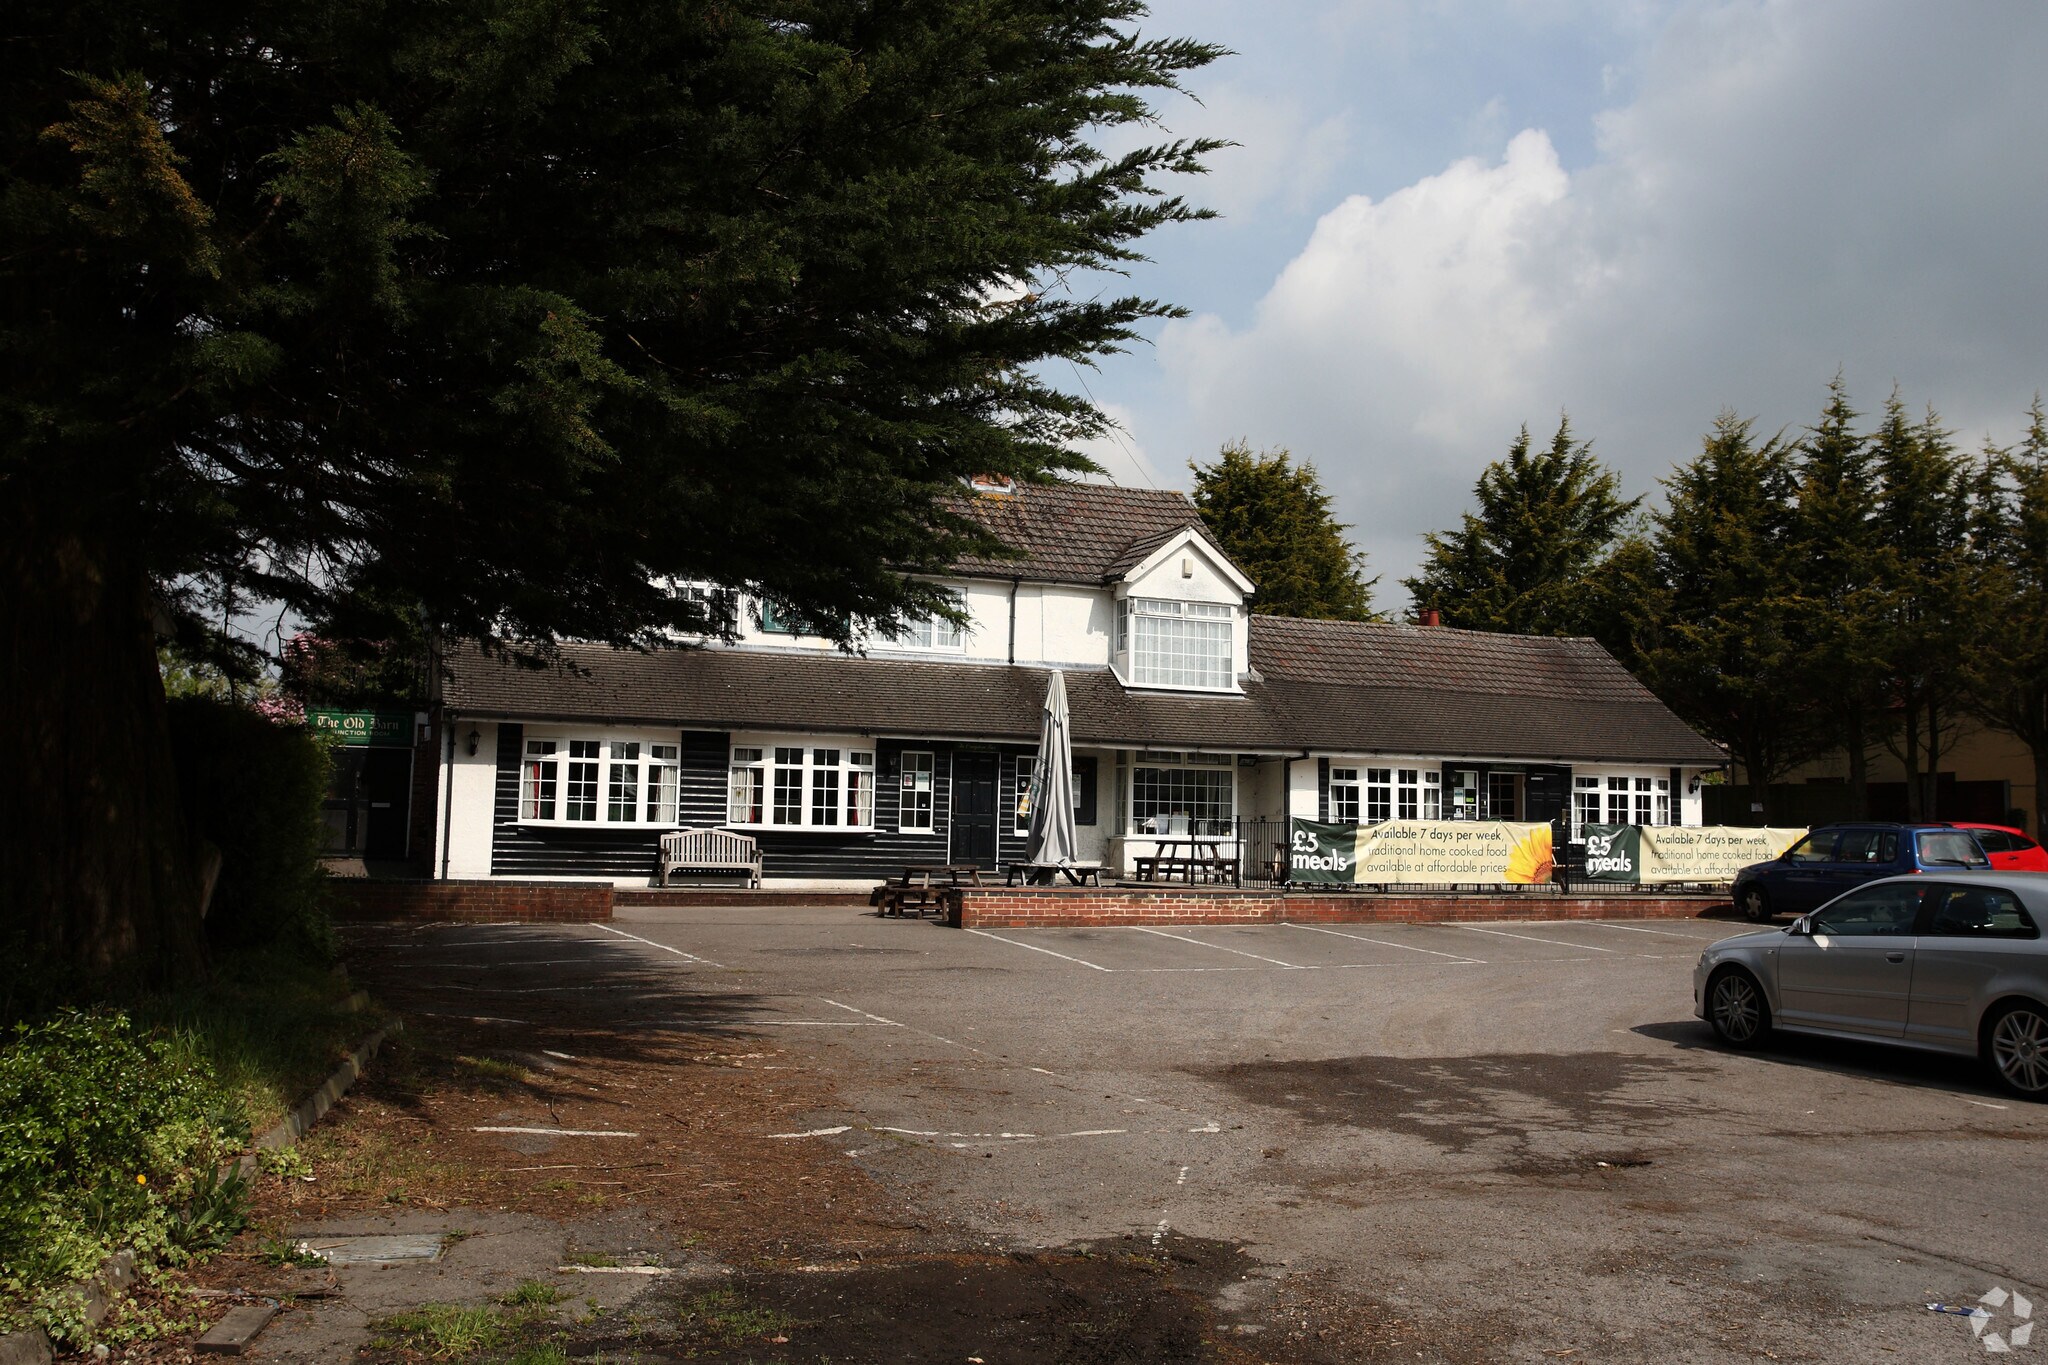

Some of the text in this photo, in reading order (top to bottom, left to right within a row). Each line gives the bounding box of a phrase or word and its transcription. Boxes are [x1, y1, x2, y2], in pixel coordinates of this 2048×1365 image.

[317, 716, 340, 728] The
[343, 717, 365, 729] Old
[1292, 830, 1319, 852] £5
[1370, 826, 1504, 843] Available 7 days per week,
[1655, 832, 1770, 847] Available 7 days per week,
[1368, 843, 1507, 857] traditional home cooked food
[1586, 835, 1611, 856] £5
[1651, 847, 1694, 860] traditional
[1696, 848, 1720, 860] home
[1292, 848, 1347, 872] meals
[1366, 859, 1507, 876] available at affordable prices
[1587, 850, 1632, 873] meals
